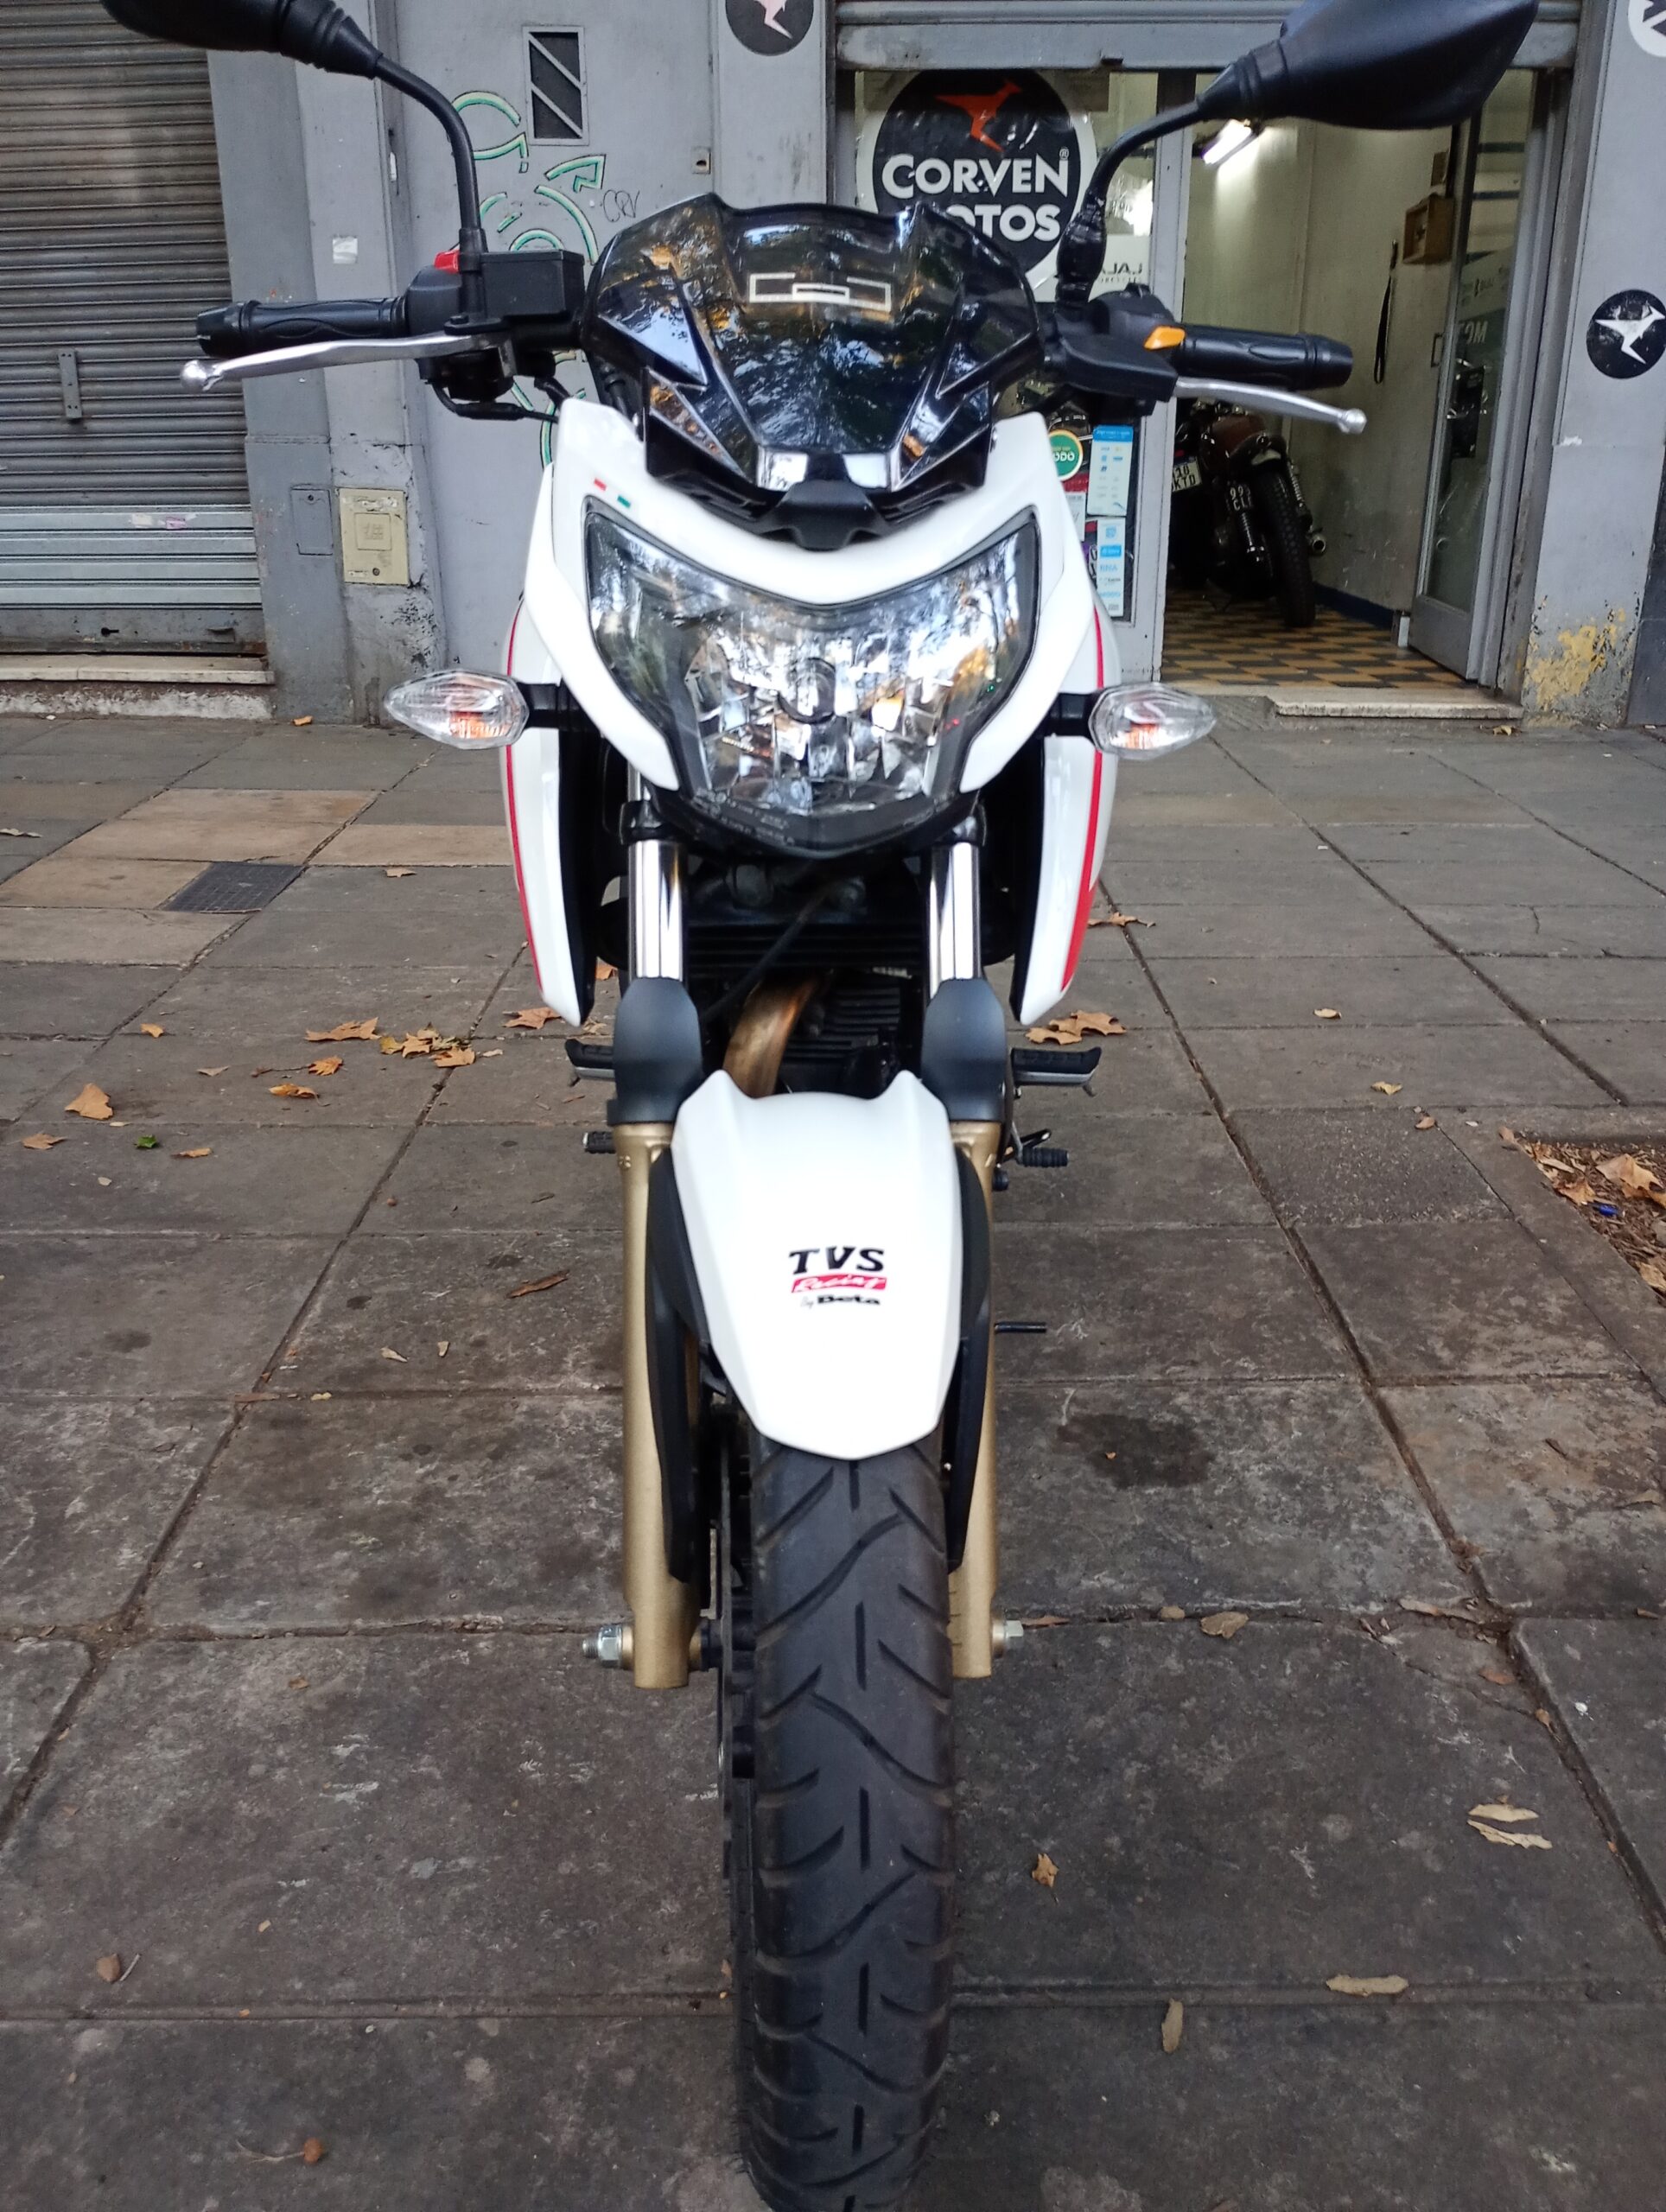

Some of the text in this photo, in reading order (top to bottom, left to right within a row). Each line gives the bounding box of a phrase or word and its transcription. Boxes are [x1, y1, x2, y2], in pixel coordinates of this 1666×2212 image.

[881, 153, 1069, 199] CORVEN
[946, 204, 1061, 242] OTOS
[1052, 449, 1075, 461] ODO
[1172, 474, 1196, 491] KTD
[788, 1245, 884, 1274] TVS
